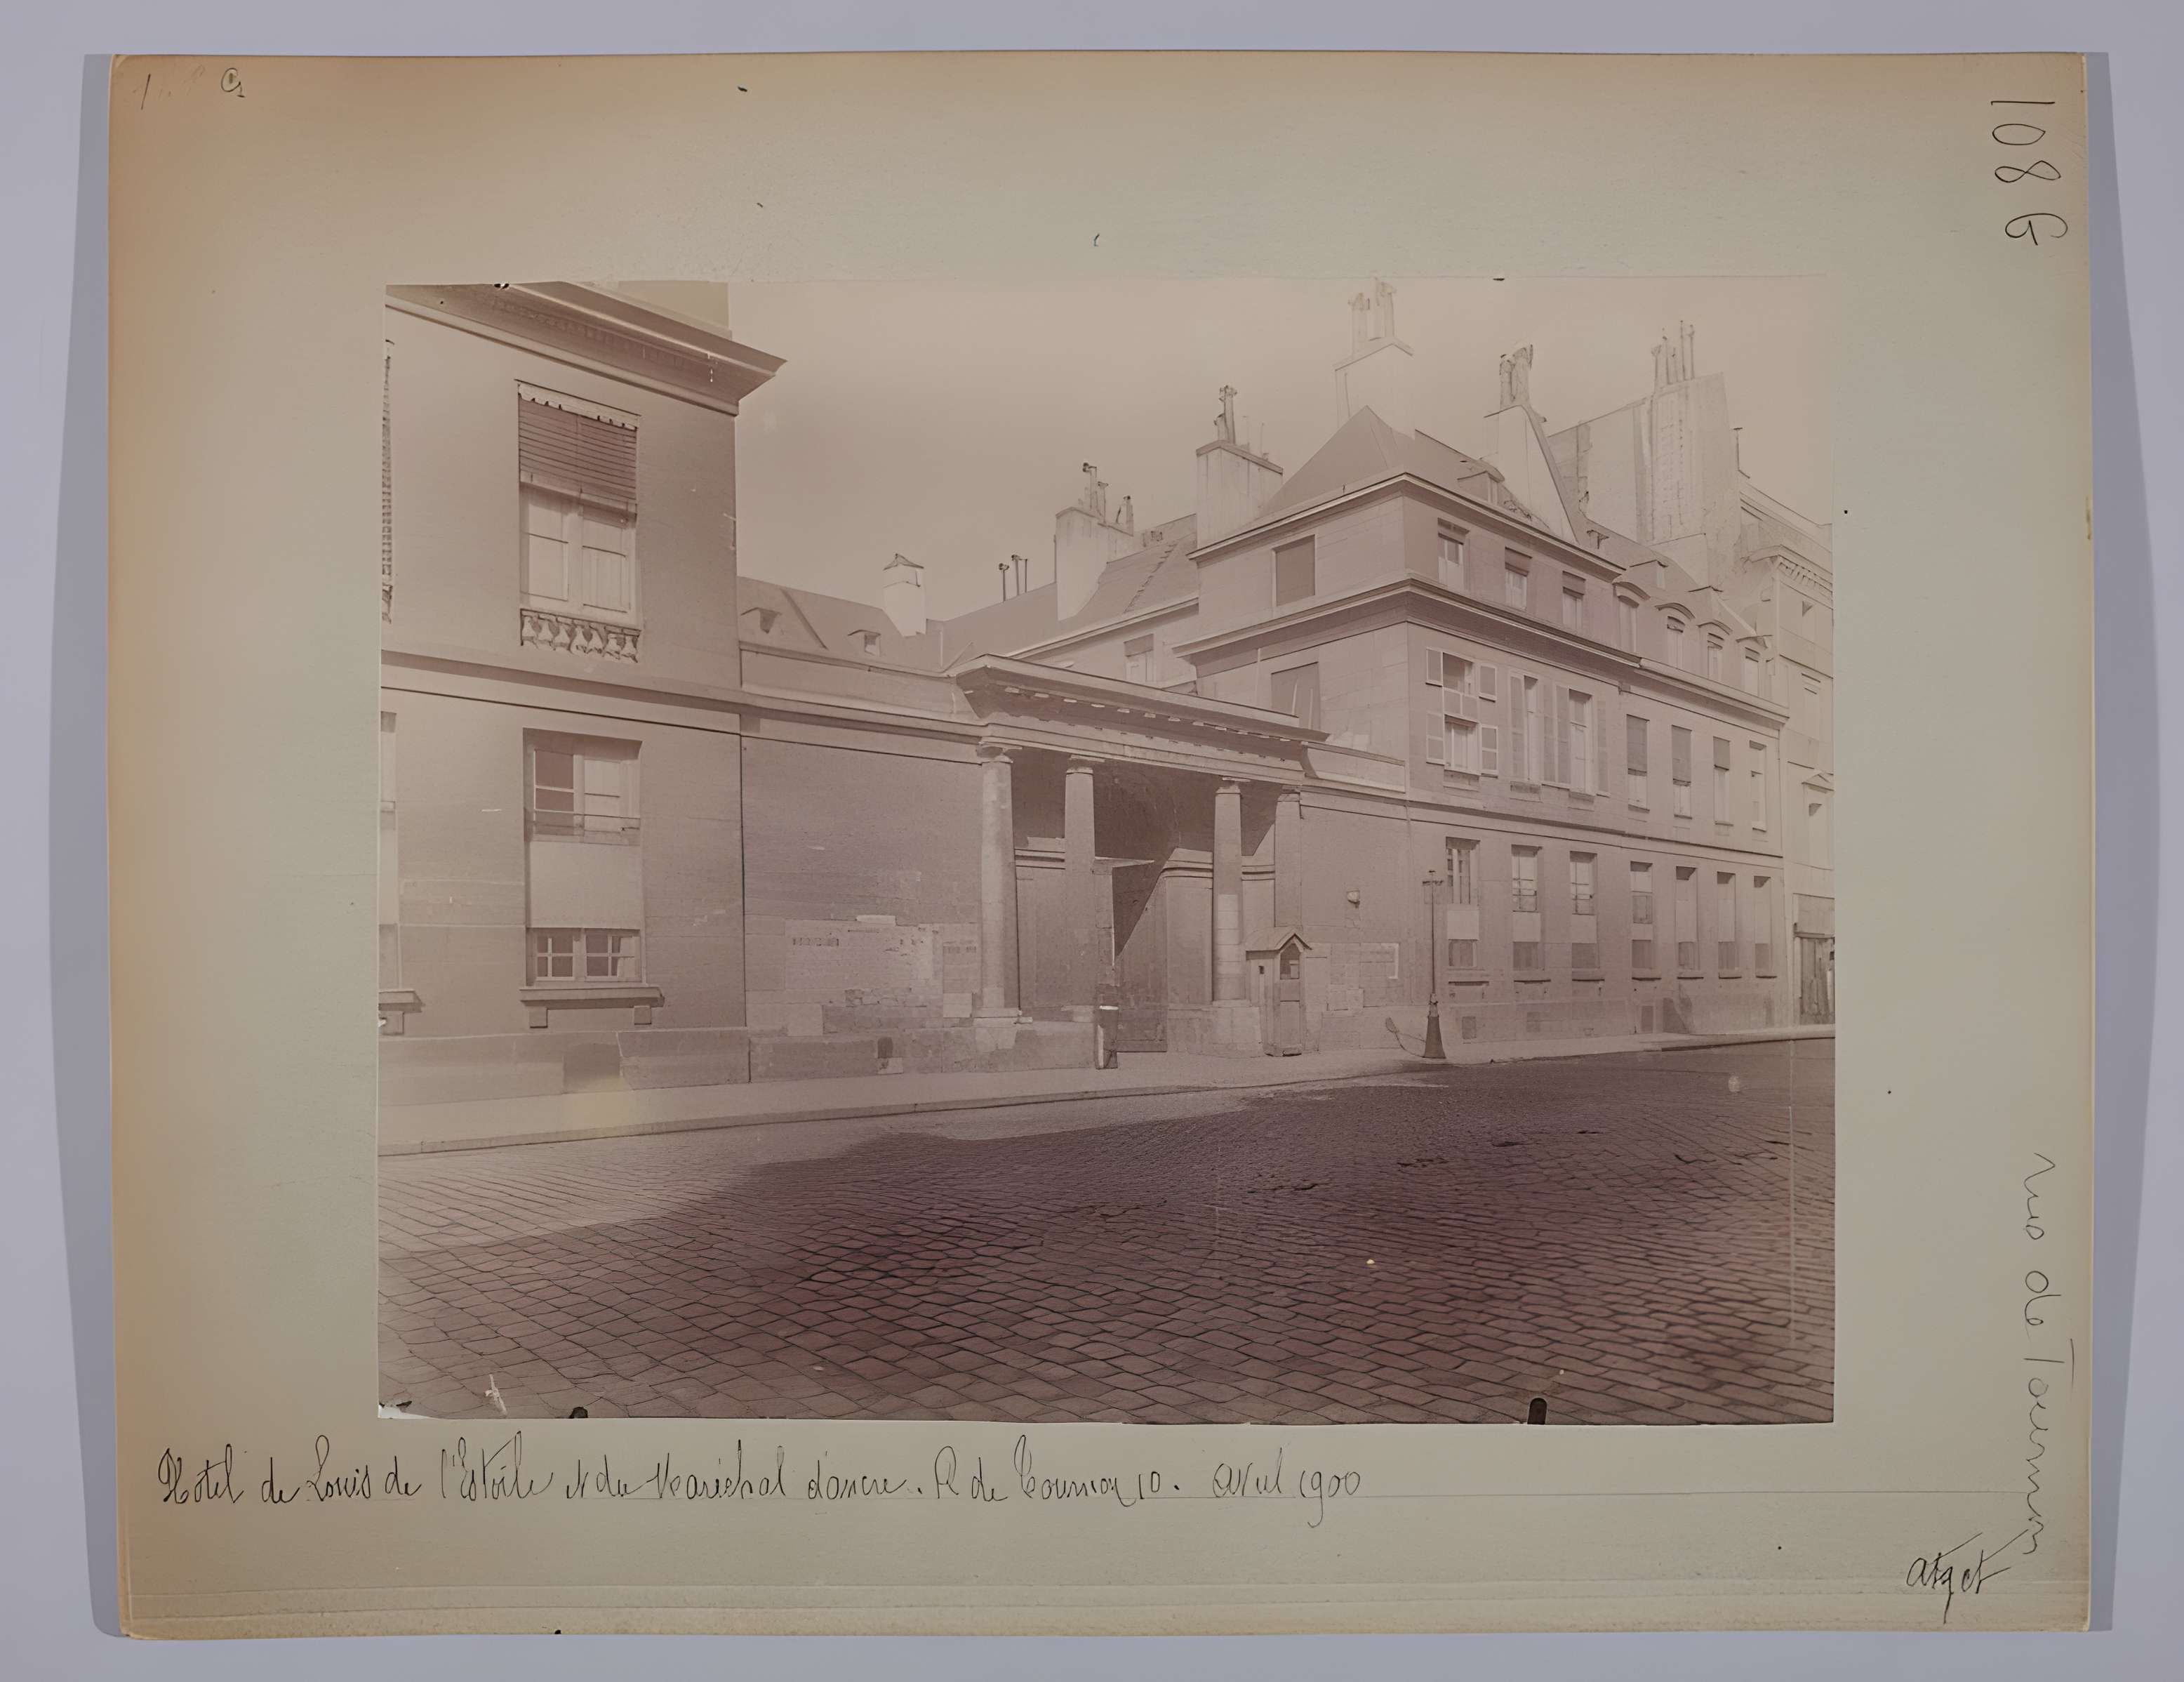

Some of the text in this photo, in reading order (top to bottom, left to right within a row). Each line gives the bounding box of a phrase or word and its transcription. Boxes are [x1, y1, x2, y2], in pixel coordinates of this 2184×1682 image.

[2024, 1270, 2061, 1339] de
[261, 1457, 300, 1504] de
[306, 1435, 371, 1502] Louis
[385, 1455, 422, 1496] de
[971, 1457, 1008, 1502] de
[1299, 1471, 1361, 1528] 1900
